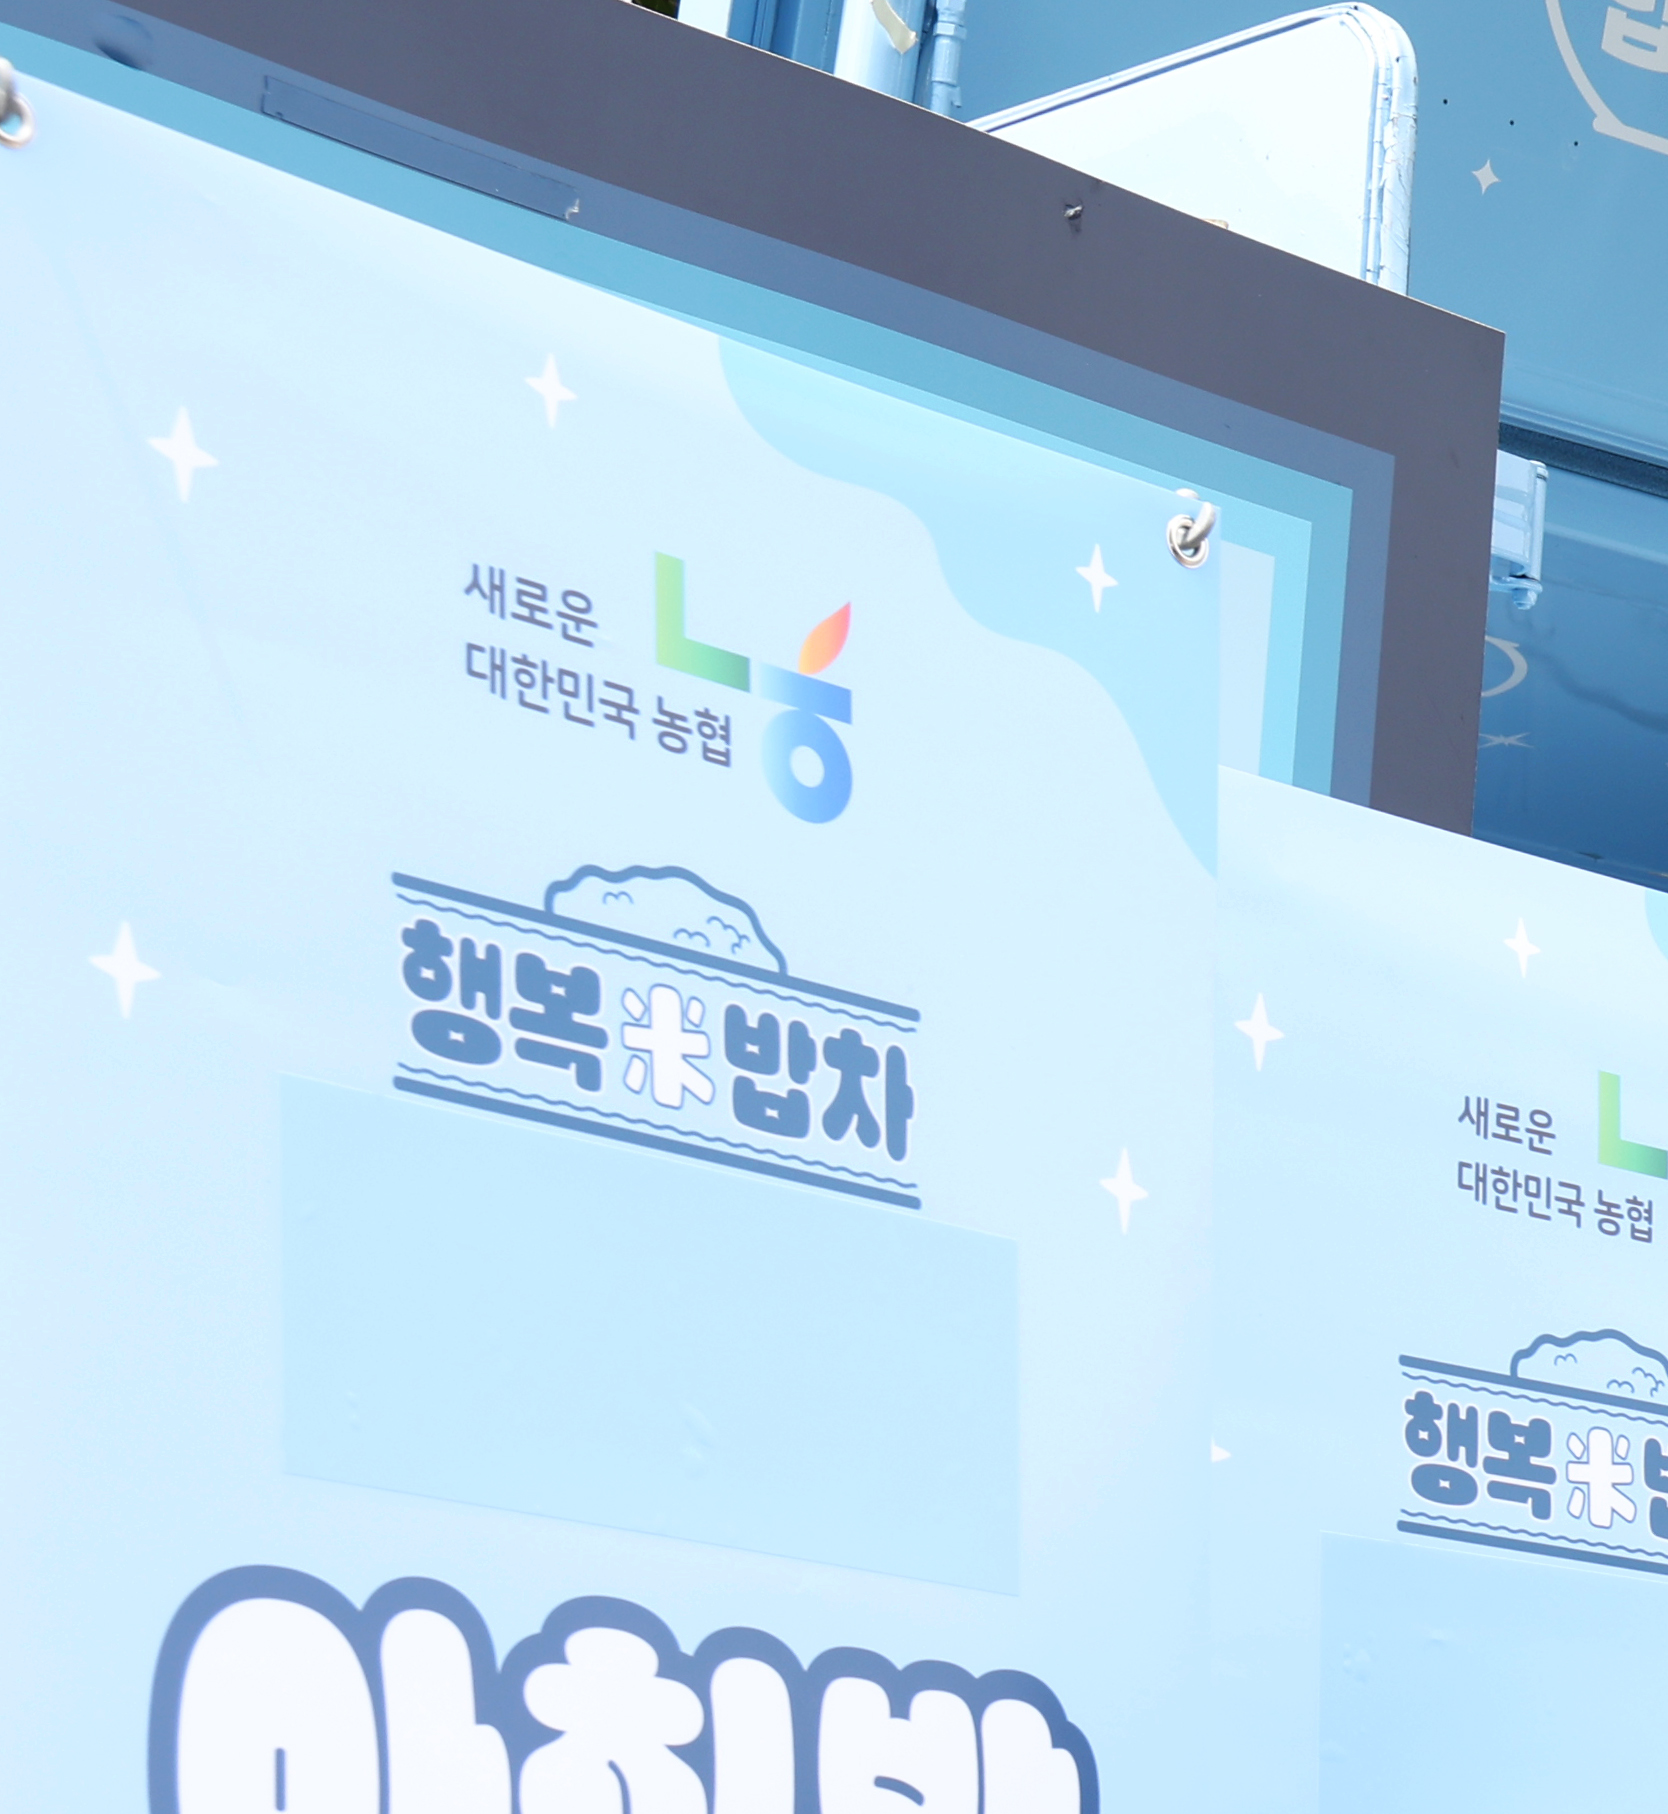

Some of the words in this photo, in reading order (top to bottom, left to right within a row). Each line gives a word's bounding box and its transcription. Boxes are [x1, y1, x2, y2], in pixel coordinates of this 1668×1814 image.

[462, 561, 598, 646] 새로운
[463, 641, 640, 740] 대한민국
[652, 698, 733, 768] 농협
[1457, 1094, 1557, 1155] 새로운
[1457, 1161, 1585, 1228] 대한민국
[1594, 1190, 1655, 1244] 농협
